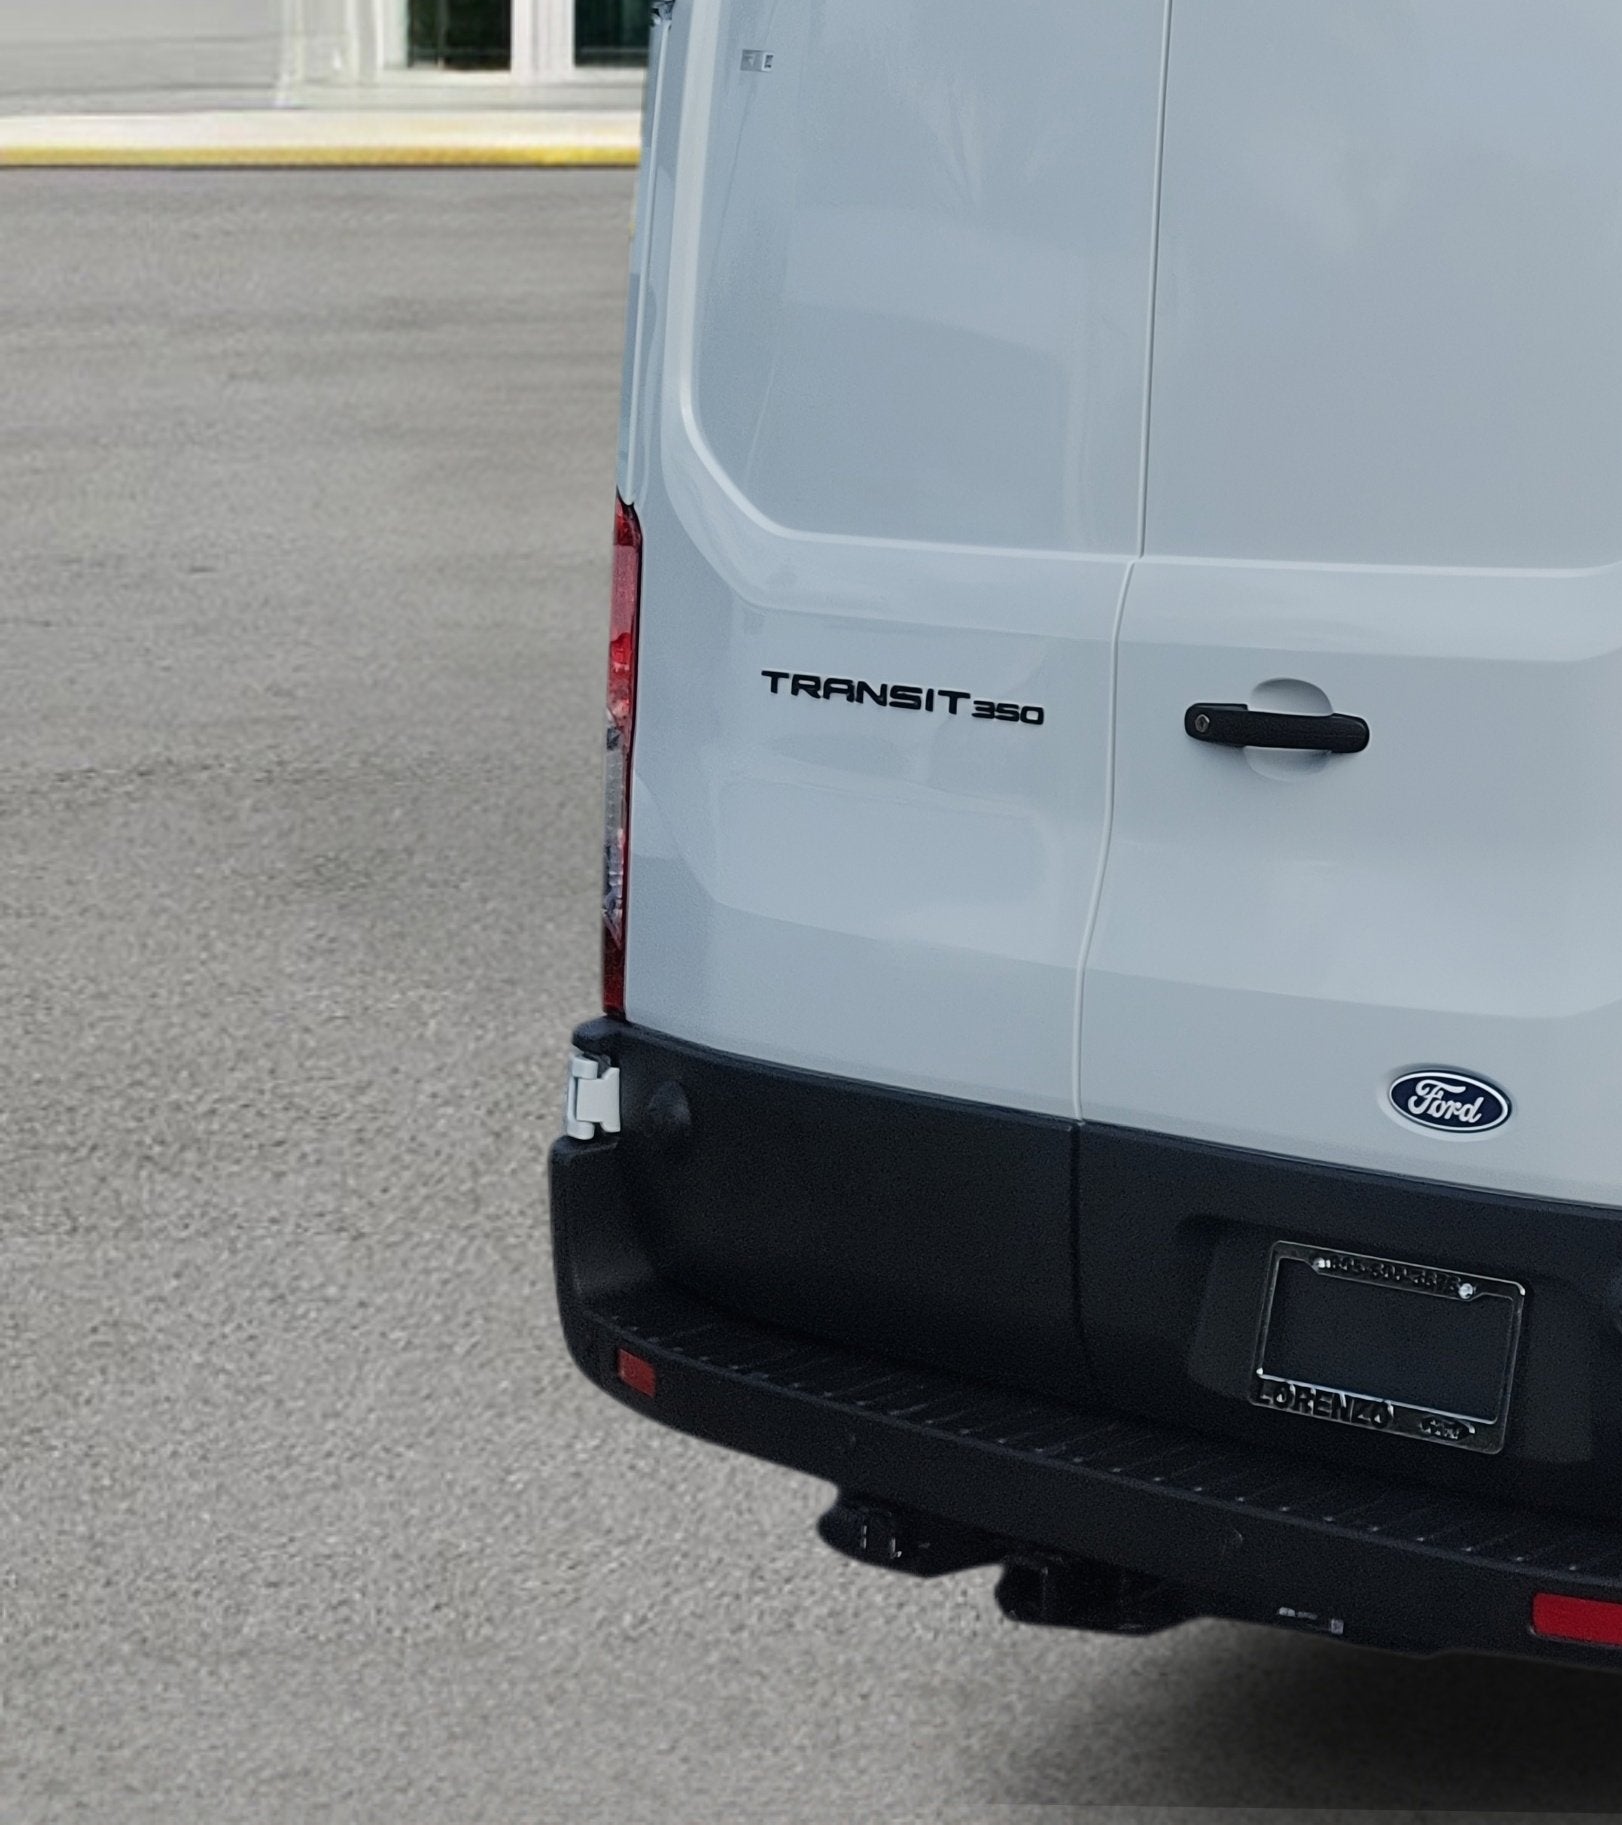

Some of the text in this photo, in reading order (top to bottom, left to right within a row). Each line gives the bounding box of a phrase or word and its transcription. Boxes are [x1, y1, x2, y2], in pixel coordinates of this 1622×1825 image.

[760, 670, 1045, 726] TRANSIT 350
[1407, 1079, 1485, 1123] Ford
